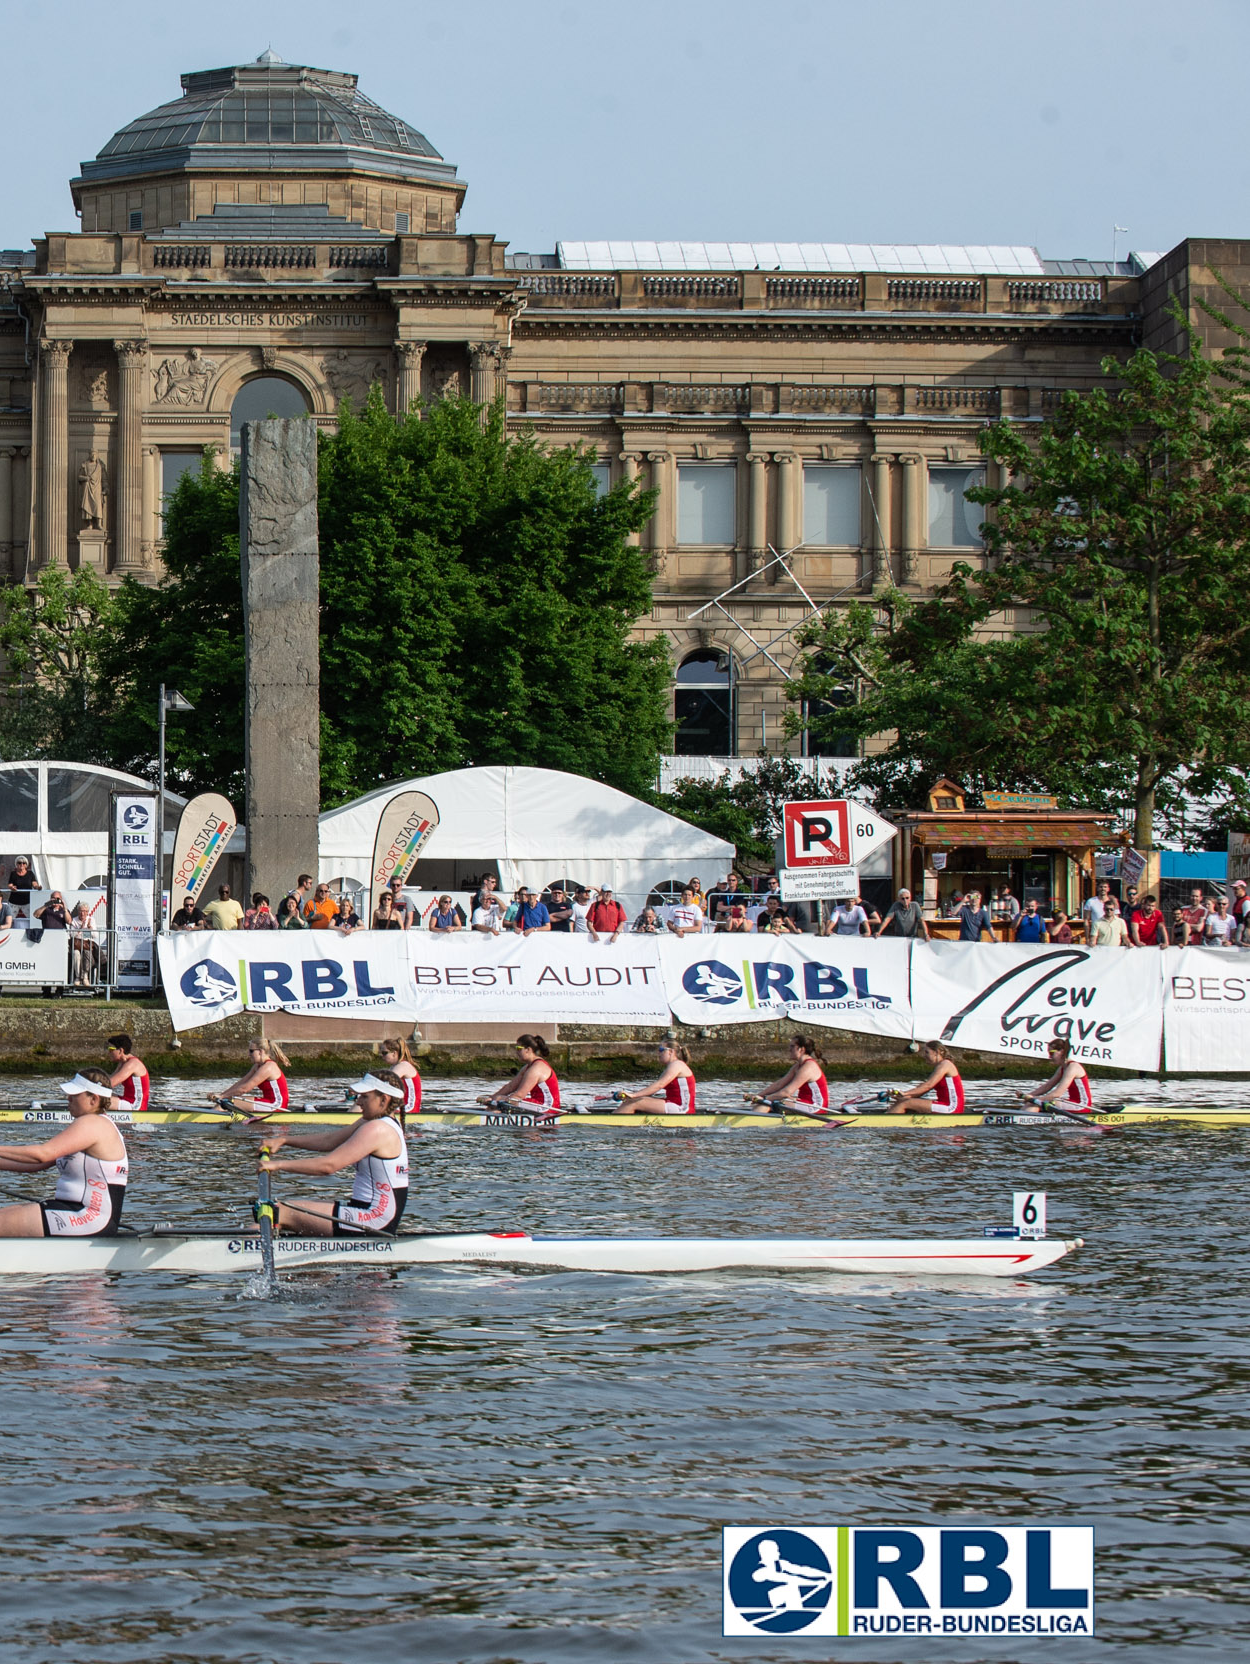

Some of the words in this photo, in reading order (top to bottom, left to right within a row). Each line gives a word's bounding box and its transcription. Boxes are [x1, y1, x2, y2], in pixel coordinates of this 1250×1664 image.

[171, 314, 263, 326] STAEDELSCHES
[269, 314, 369, 326] KUNSTINSTITUT
[415, 843, 422, 853] AM
[422, 823, 436, 840] MAIN
[802, 817, 832, 851] P
[856, 823, 874, 837] 60
[123, 835, 148, 844] RBL
[375, 811, 423, 885] SPORTSTADT
[174, 812, 221, 887] SPORTSTADT
[193, 856, 214, 895] FRANKFURT
[214, 845, 221, 855] AM
[221, 825, 233, 842] MAIN
[784, 872, 817, 880] Ausgenommen
[818, 870, 854, 879] Fahrgastschiffe
[804, 881, 835, 889] Genehmigung
[5, 962, 36, 970] GMBH
[249, 959, 395, 1003] RBL
[414, 966, 521, 986] BEST
[537, 966, 656, 986] AUDIT
[753, 961, 892, 1003] RBL
[1172, 976, 1250, 1001] BES
[1000, 1035, 1112, 1060] SPORTWEAR
[36, 1112, 59, 1120] RBL
[996, 1115, 1017, 1123] RBL
[87, 1179, 106, 1190] 8
[376, 1182, 390, 1191] 8
[1022, 1194, 1037, 1224] 6
[279, 1241, 392, 1252] RUDER-BUNDESLIGA
